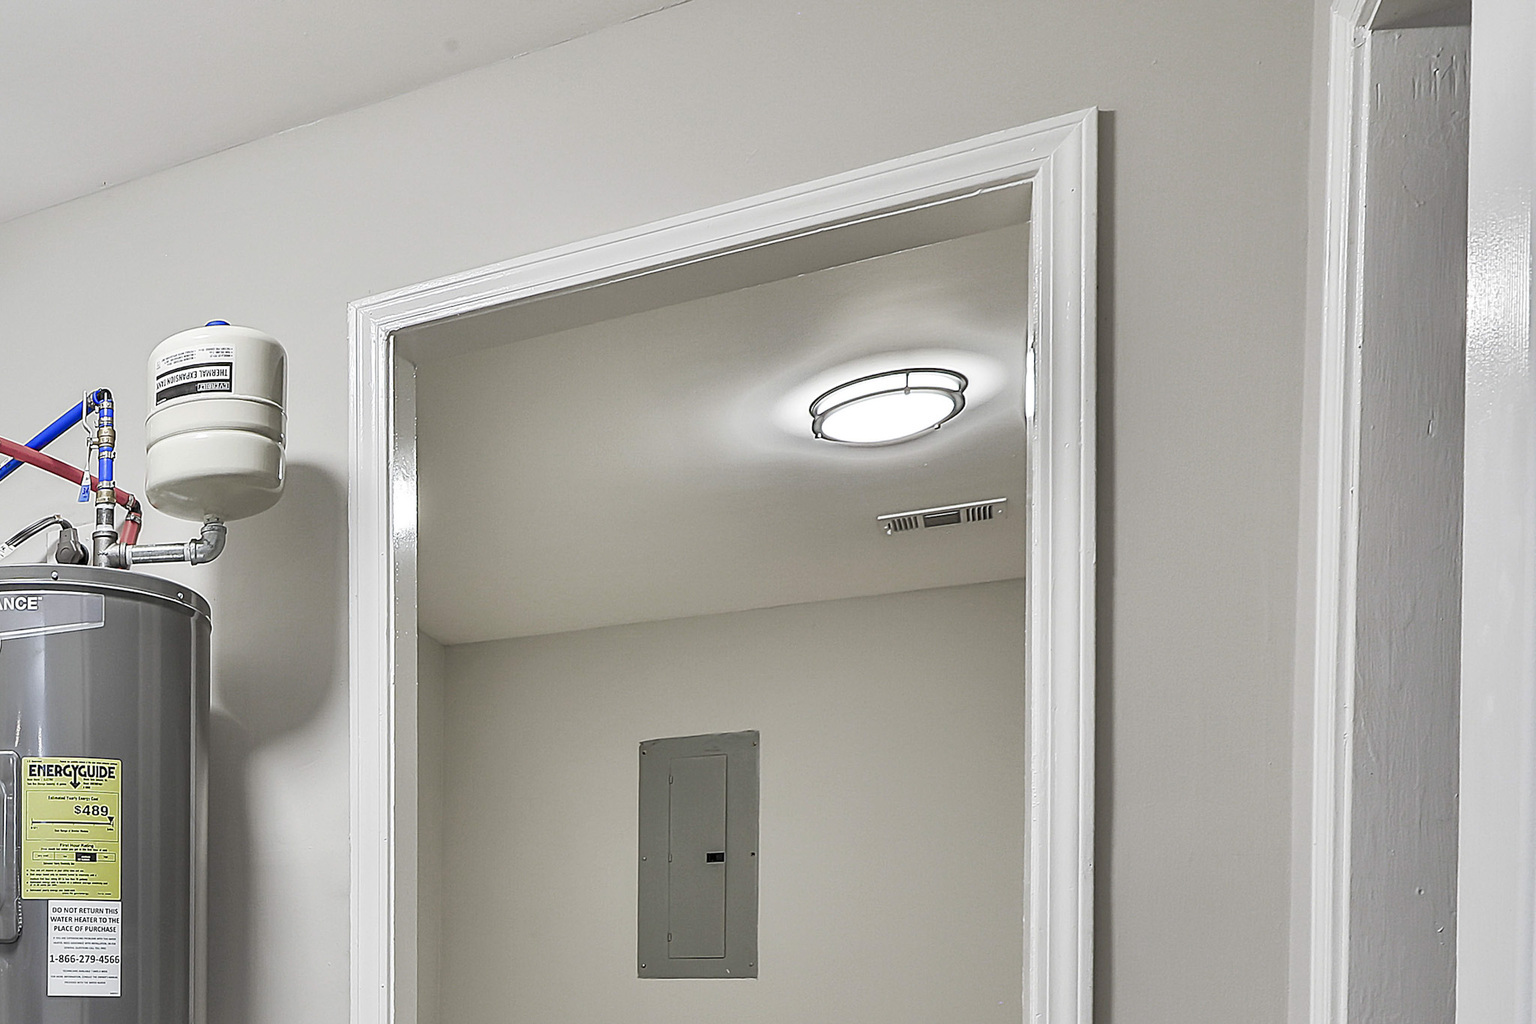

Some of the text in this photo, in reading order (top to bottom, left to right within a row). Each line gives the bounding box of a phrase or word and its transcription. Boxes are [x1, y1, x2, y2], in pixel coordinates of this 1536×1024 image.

[167, 370, 198, 384] EXPANSION
[199, 368, 228, 378] THERMAL
[74, 804, 109, 816] $489
[50, 954, 120, 964] 1-866-279-4566
